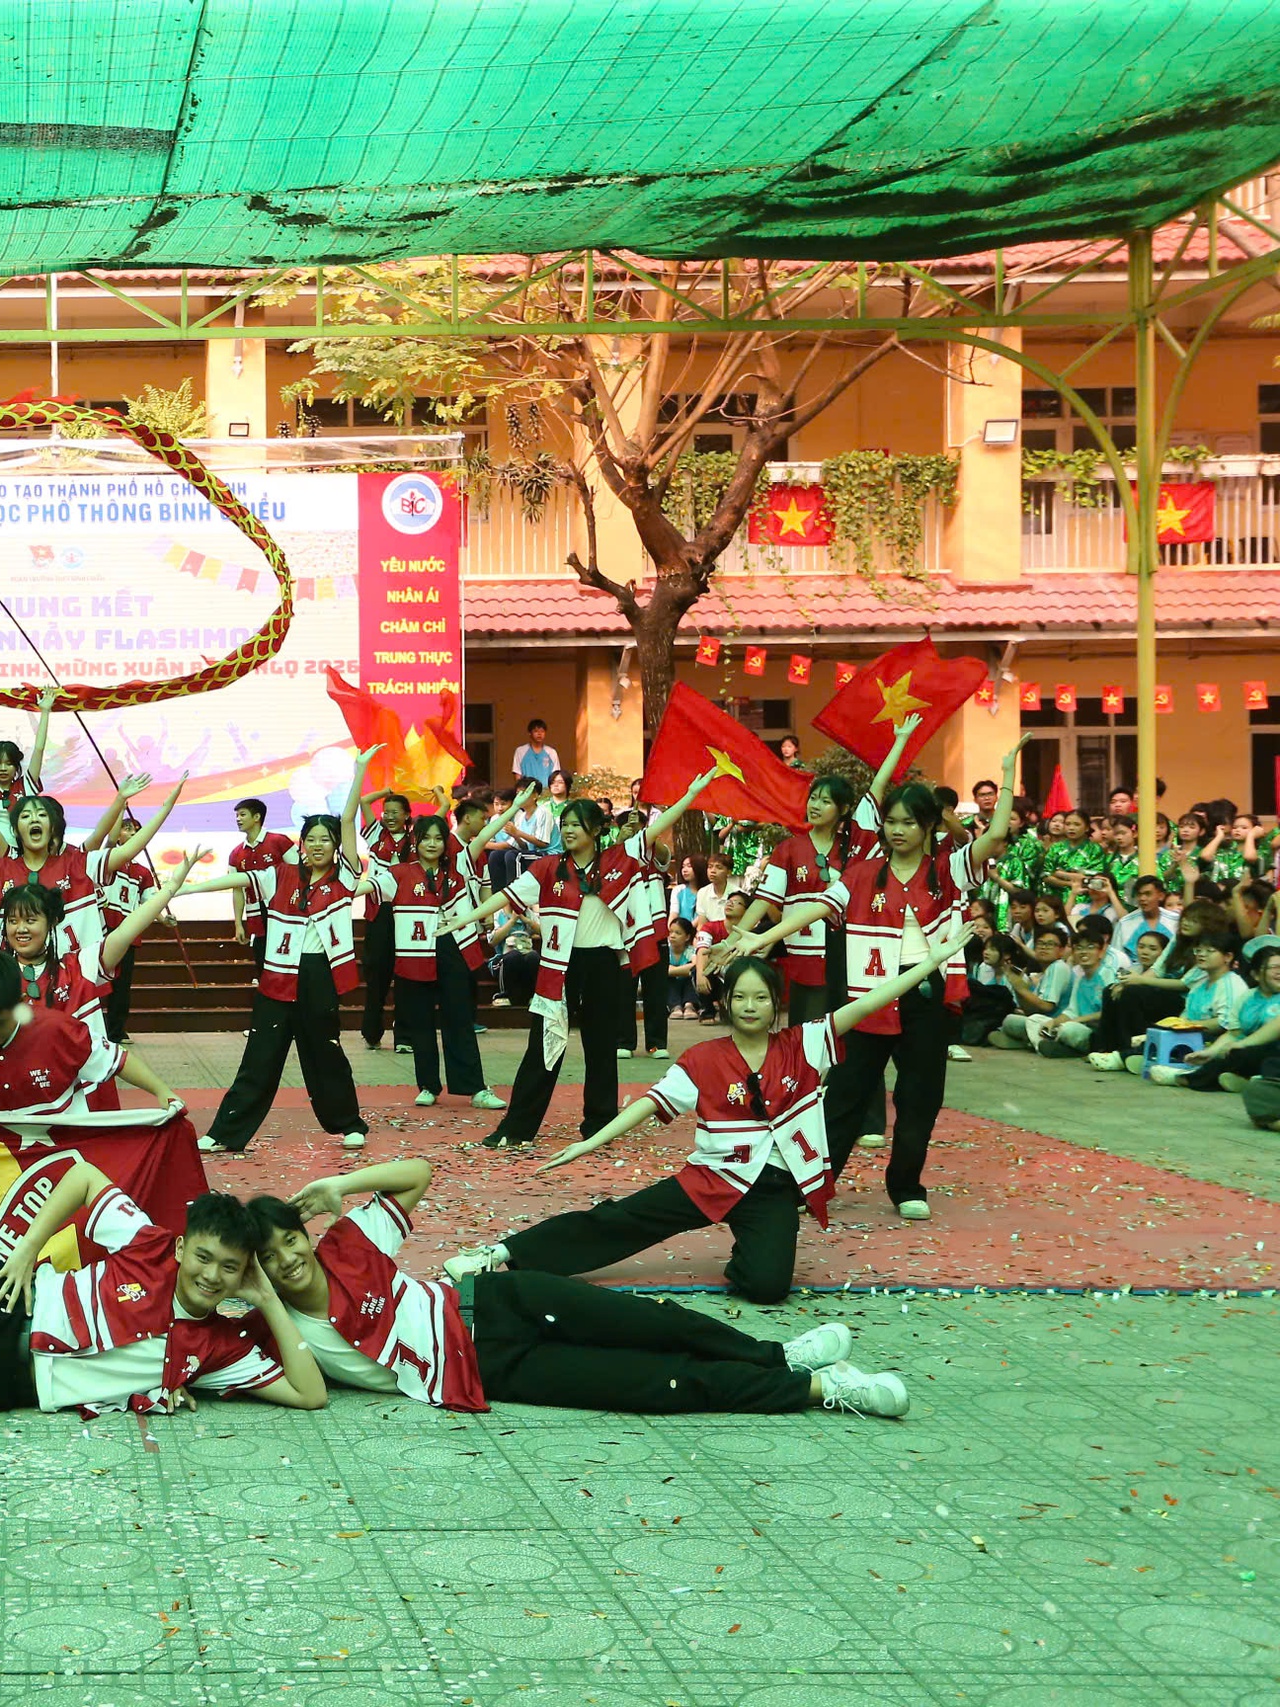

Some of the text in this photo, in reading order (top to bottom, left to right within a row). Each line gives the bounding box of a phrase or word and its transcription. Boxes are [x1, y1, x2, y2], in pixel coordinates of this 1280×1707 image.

[14, 485, 42, 500] TẠO
[78, 498, 151, 523] THÔNG
[380, 556, 446, 572] YÊU NƯỚC
[387, 587, 440, 603] NHÂN ÁI
[380, 618, 446, 633] CHĂM CHỈ
[95, 628, 261, 650] FLASHMO
[124, 657, 184, 676] XUÂN
[374, 650, 452, 666] TRUNG THỰC
[367, 677, 414, 694] TRÁCH
[62, 924, 81, 953] 1
[411, 920, 428, 942] A
[276, 932, 292, 955] A
[863, 947, 887, 977] A
[791, 1128, 821, 1166] 1
[11, 1176, 54, 1225] TOP
[360, 1301, 369, 1315] WE
